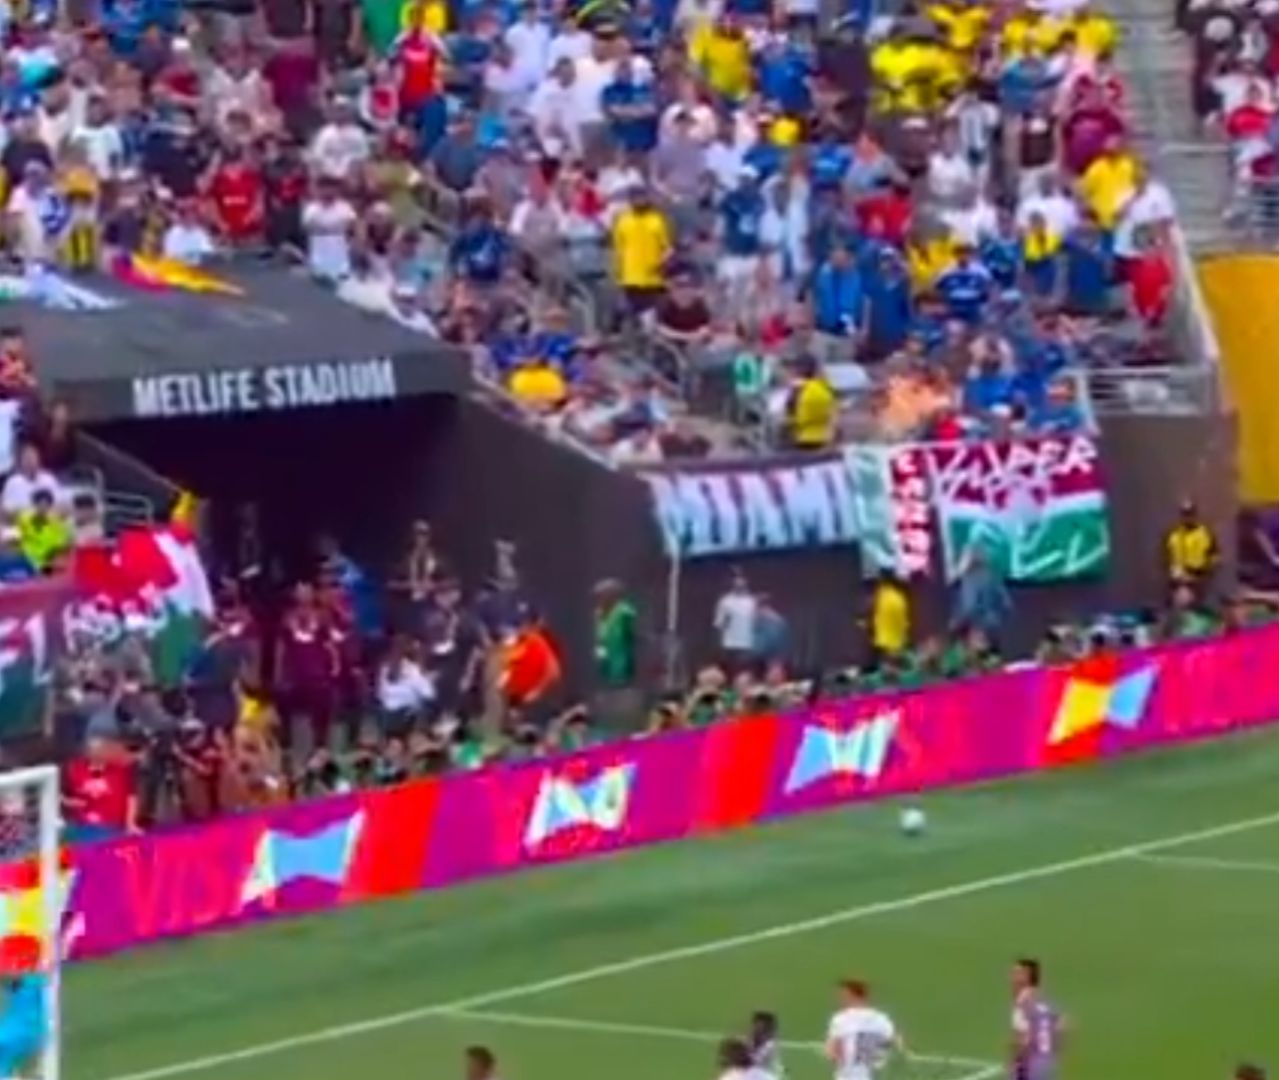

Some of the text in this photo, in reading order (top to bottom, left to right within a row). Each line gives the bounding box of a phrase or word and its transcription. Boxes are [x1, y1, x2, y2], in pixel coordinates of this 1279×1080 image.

[132, 356, 397, 419] METLIFE STADIUM
[645, 456, 858, 558] MIAMI
